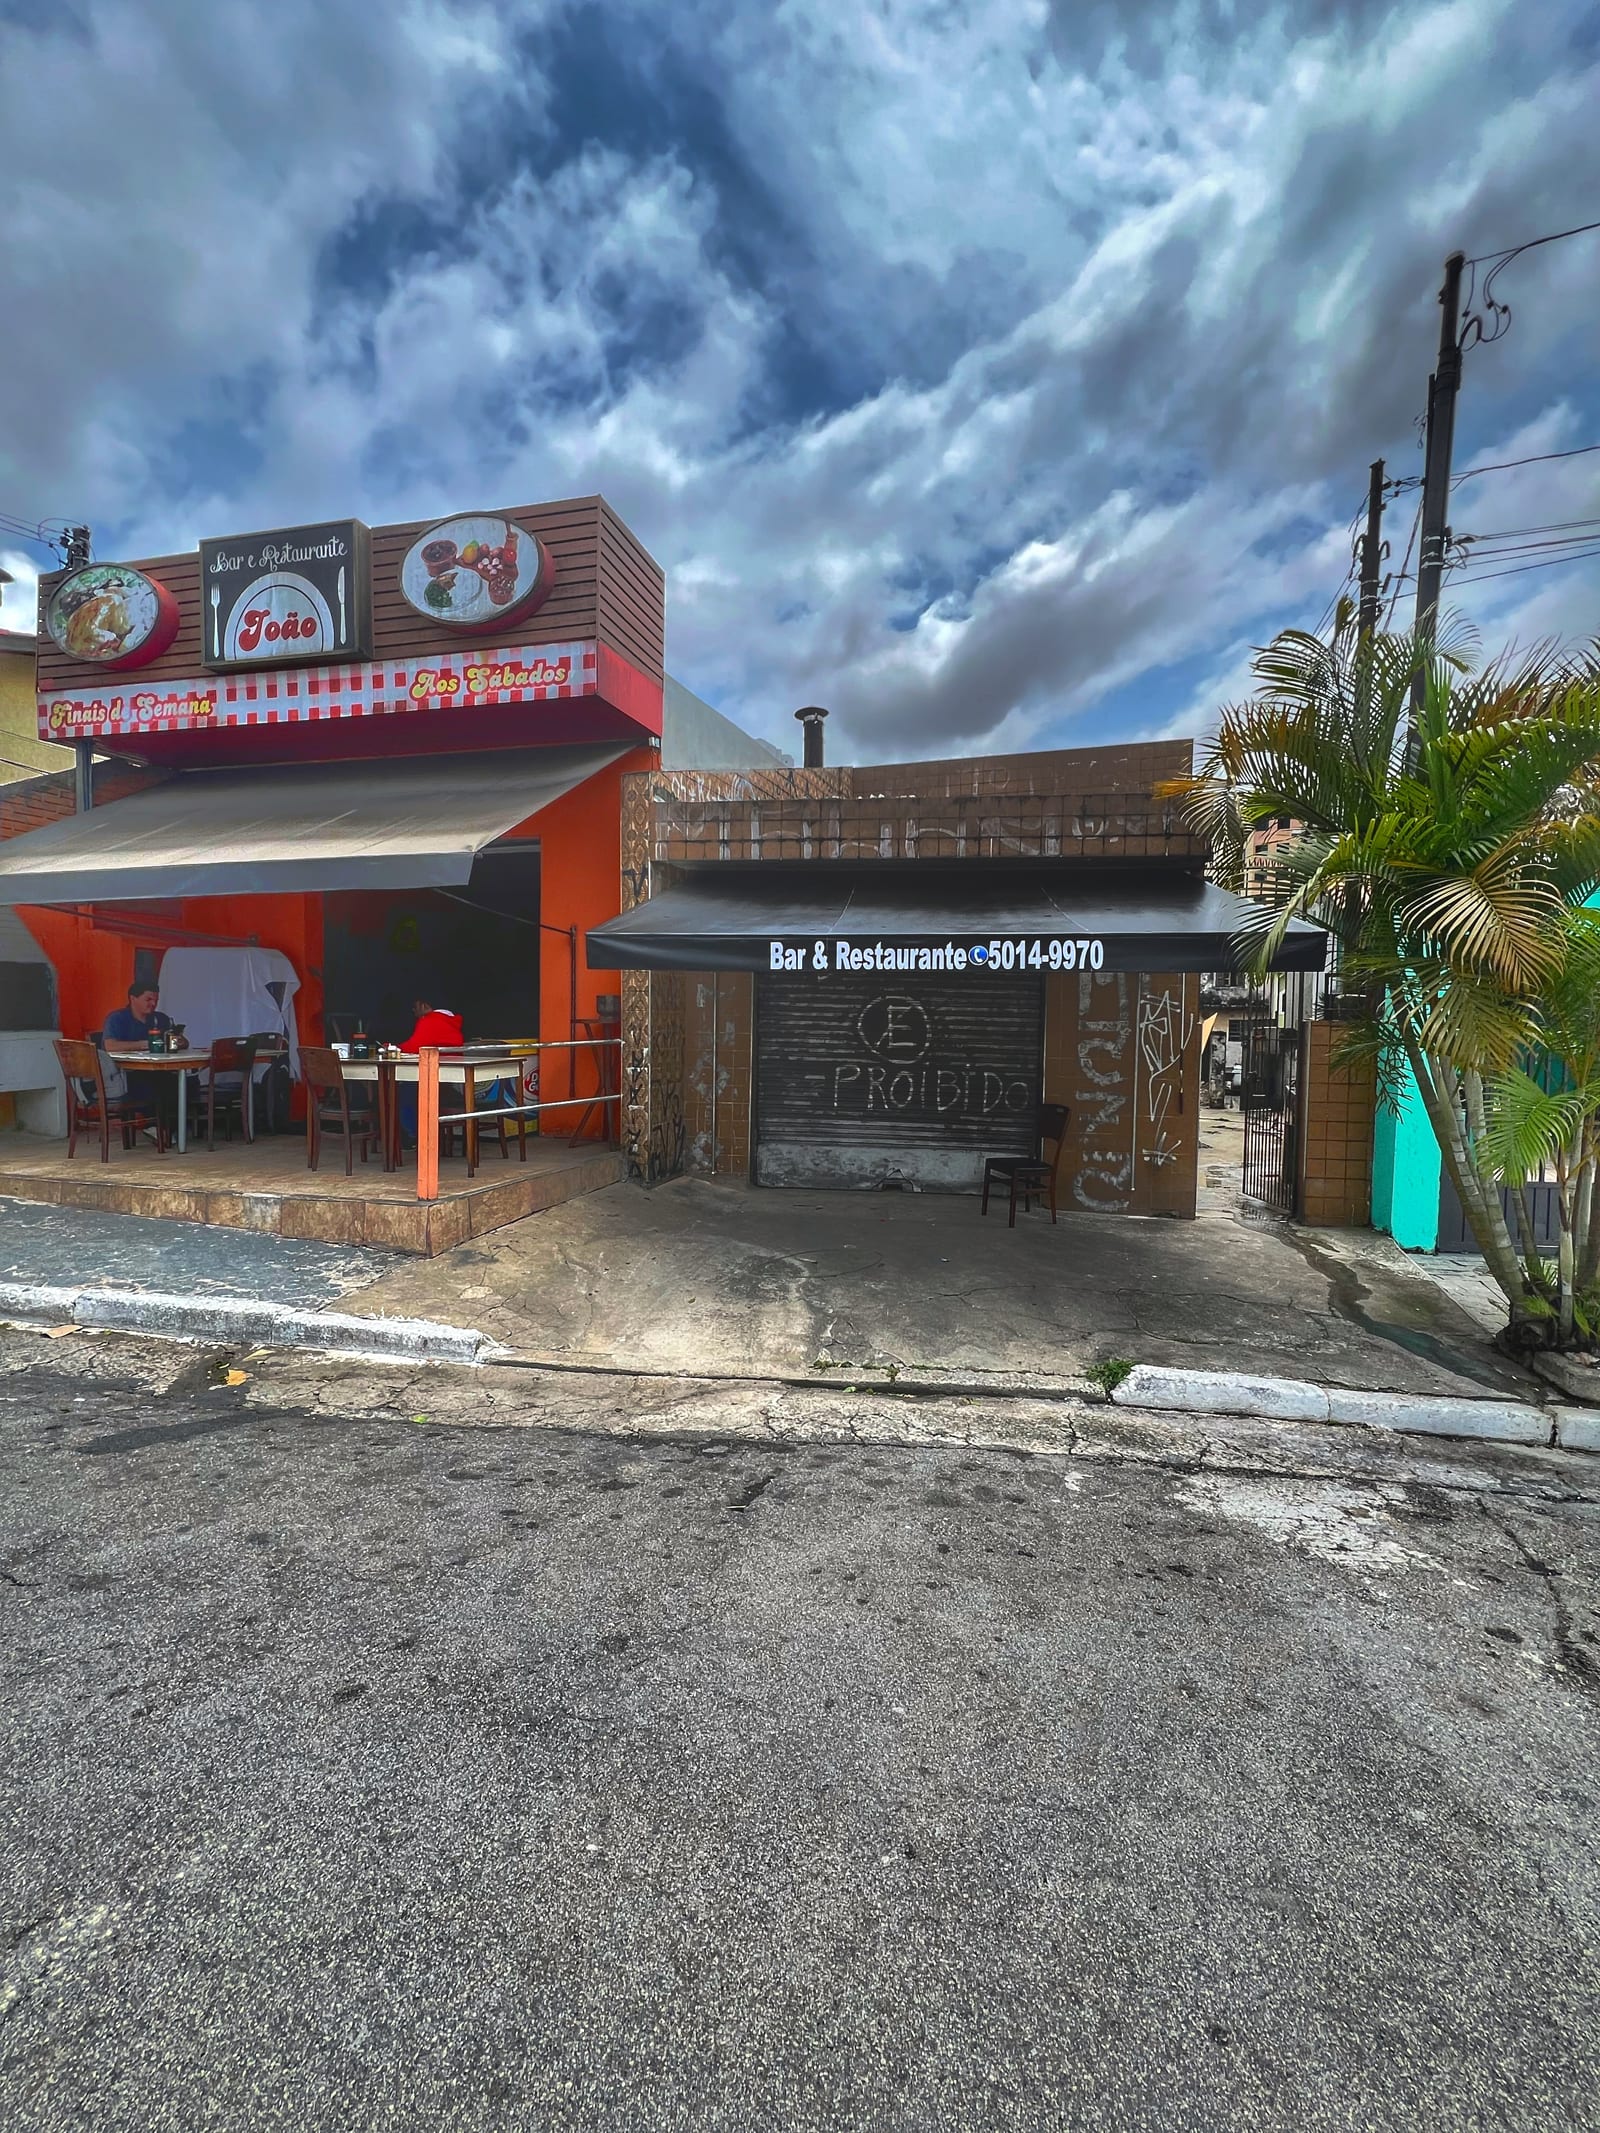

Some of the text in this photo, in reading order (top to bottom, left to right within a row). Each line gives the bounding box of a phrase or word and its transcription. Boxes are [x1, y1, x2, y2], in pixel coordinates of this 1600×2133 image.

[209, 535, 348, 573] Bar e Restaurante
[238, 609, 318, 652] João
[411, 662, 567, 699] Aos Sábados
[50, 702, 106, 729] Finais
[136, 694, 213, 723] Semana
[769, 940, 1104, 971] Bar & Restaurante 5014-9970
